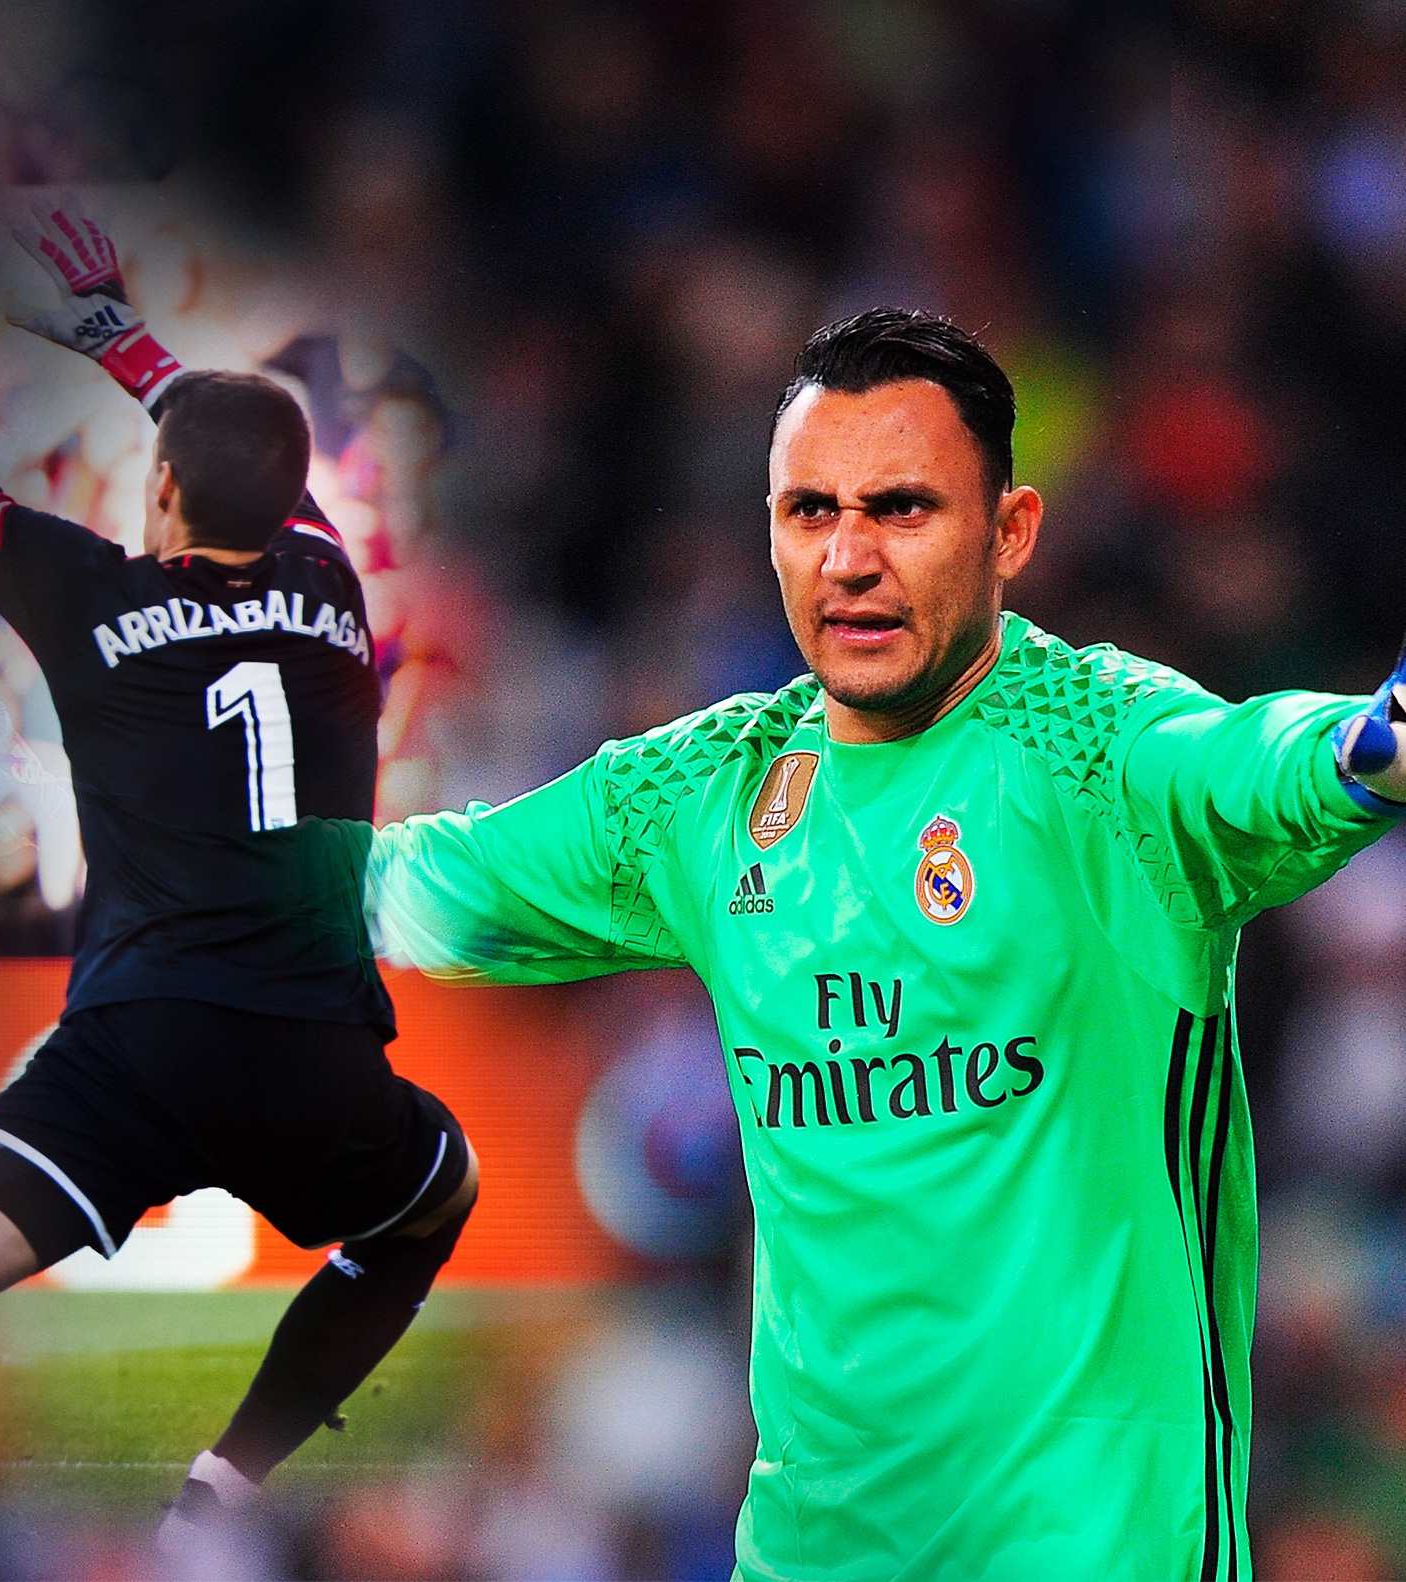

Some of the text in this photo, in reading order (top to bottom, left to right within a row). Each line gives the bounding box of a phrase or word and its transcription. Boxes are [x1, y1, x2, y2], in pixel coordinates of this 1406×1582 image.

[93, 590, 370, 668] ARRIZABALAGA
[206, 661, 298, 832] 1
[759, 812, 786, 827] FIFA
[728, 894, 774, 915] adidas
[814, 971, 903, 1038] Fly
